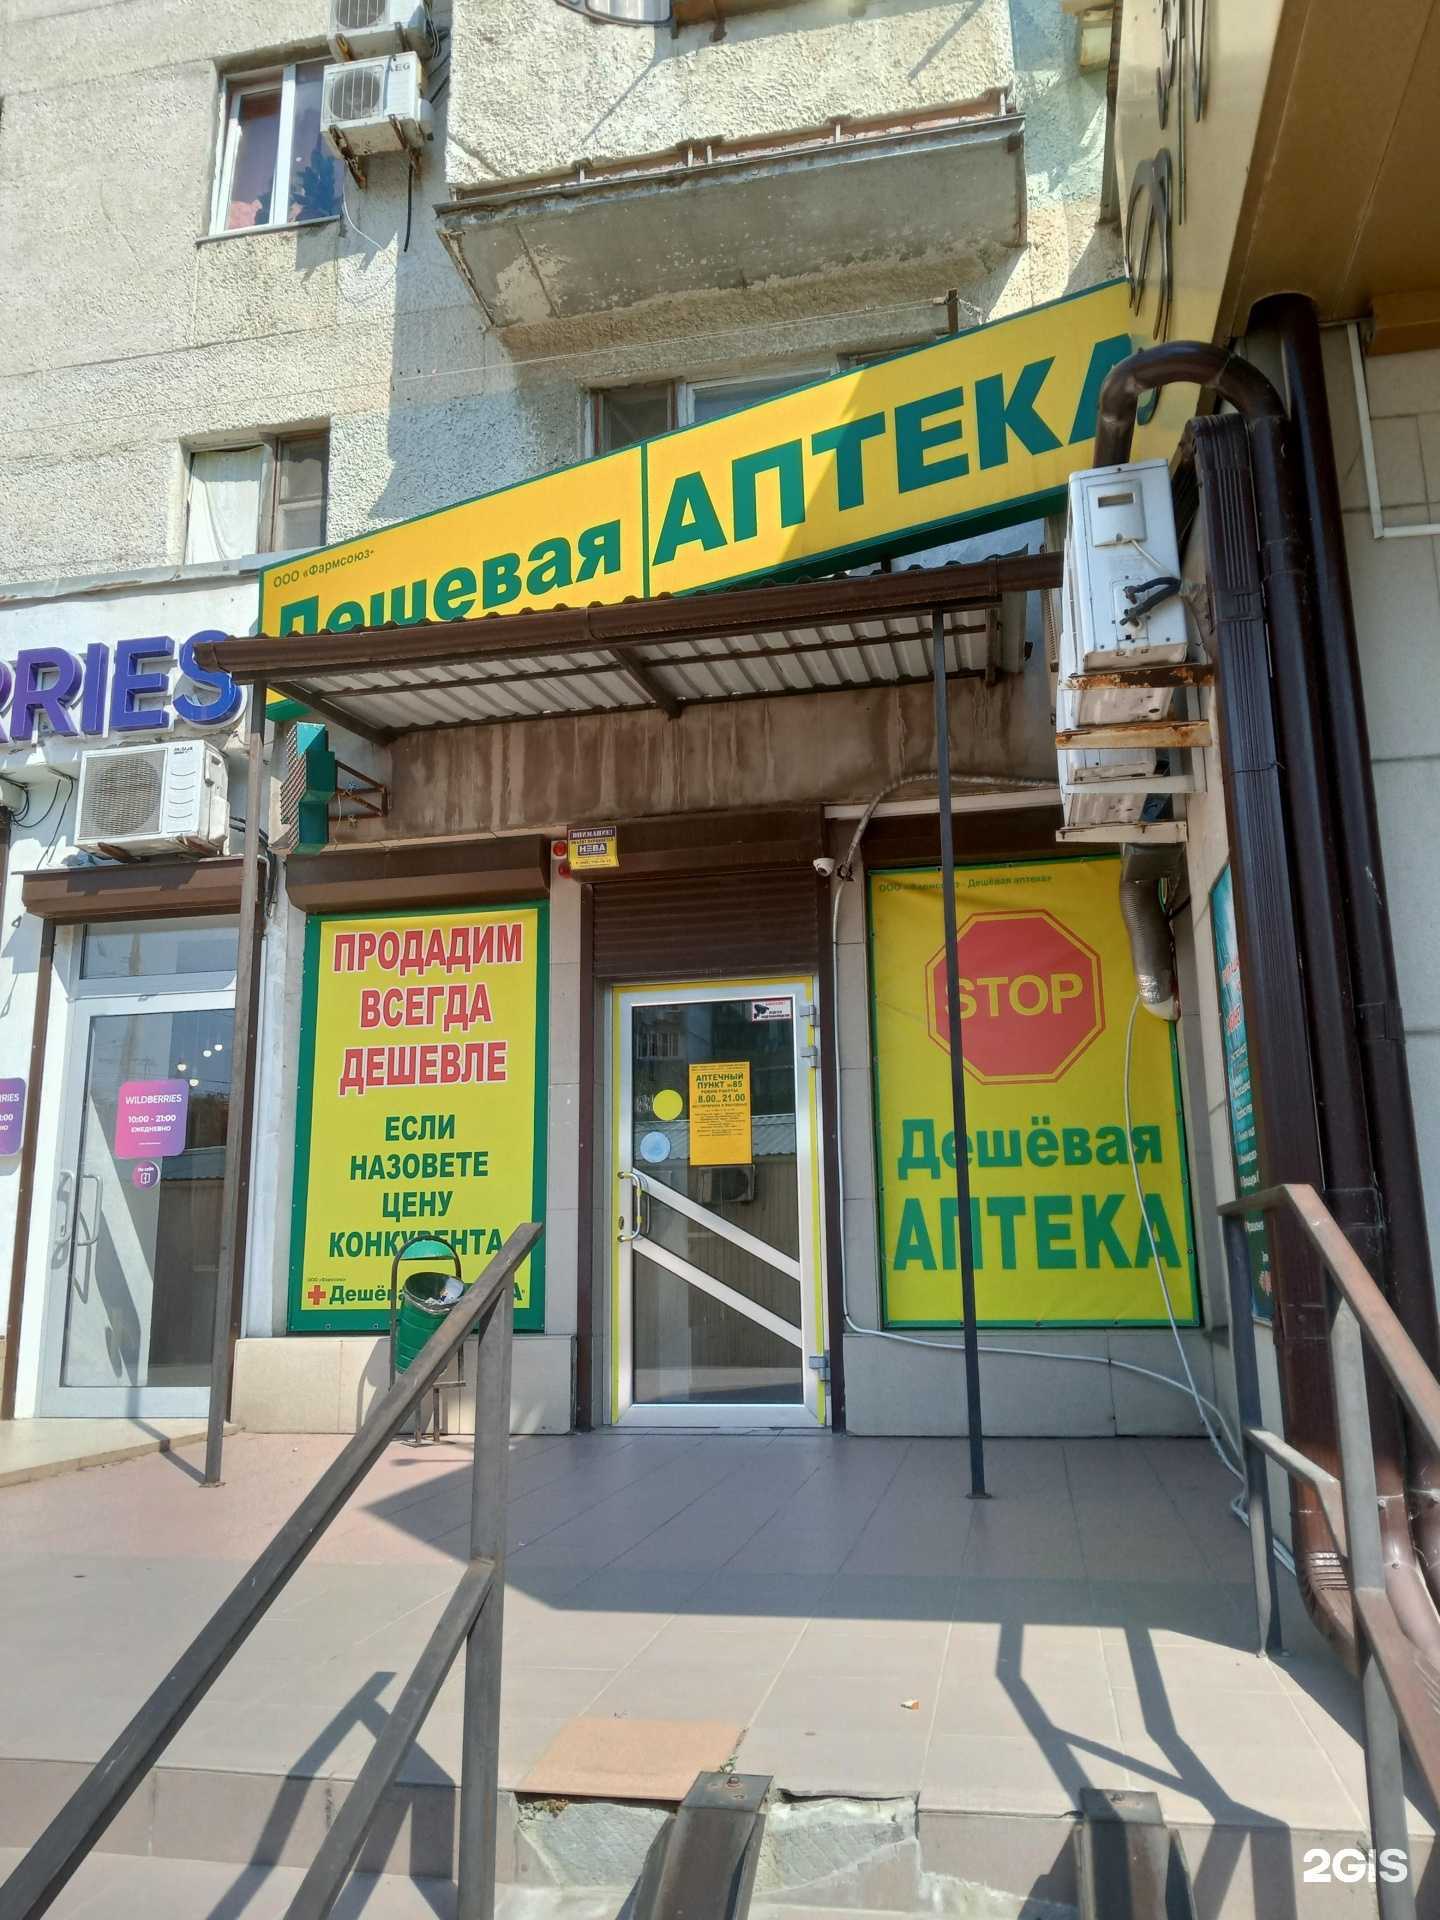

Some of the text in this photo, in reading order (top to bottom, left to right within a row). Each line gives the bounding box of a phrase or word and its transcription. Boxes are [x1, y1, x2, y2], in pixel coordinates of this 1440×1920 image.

[273, 570, 300, 588] ООО
[0, 629, 243, 743] RIES
[333, 923, 523, 977] ПРОДАДИМ
[360, 983, 492, 1032] ВСЕГДА
[945, 972, 1084, 1020] STOP
[339, 1041, 507, 1096] ДЕШЕВЛЕ
[696, 1073, 743, 1081] АПТЕЧНЫЙ
[125, 1094, 183, 1105] WILDBERRIES
[697, 1081, 724, 1089] ПУНКТ
[128, 1115, 150, 1124] 10:00
[155, 1114, 177, 1122] 21:00
[385, 1114, 456, 1141] ЕСЛИ
[897, 1116, 1164, 1180] Дешёвая
[350, 1151, 489, 1180] НАЗОВЕТЕ
[382, 1190, 454, 1222] ЦЕНУ
[329, 1228, 503, 1258] КОНКНТА
[893, 1193, 1182, 1271] АПТЕКА
[329, 1285, 405, 1304] Дешё
